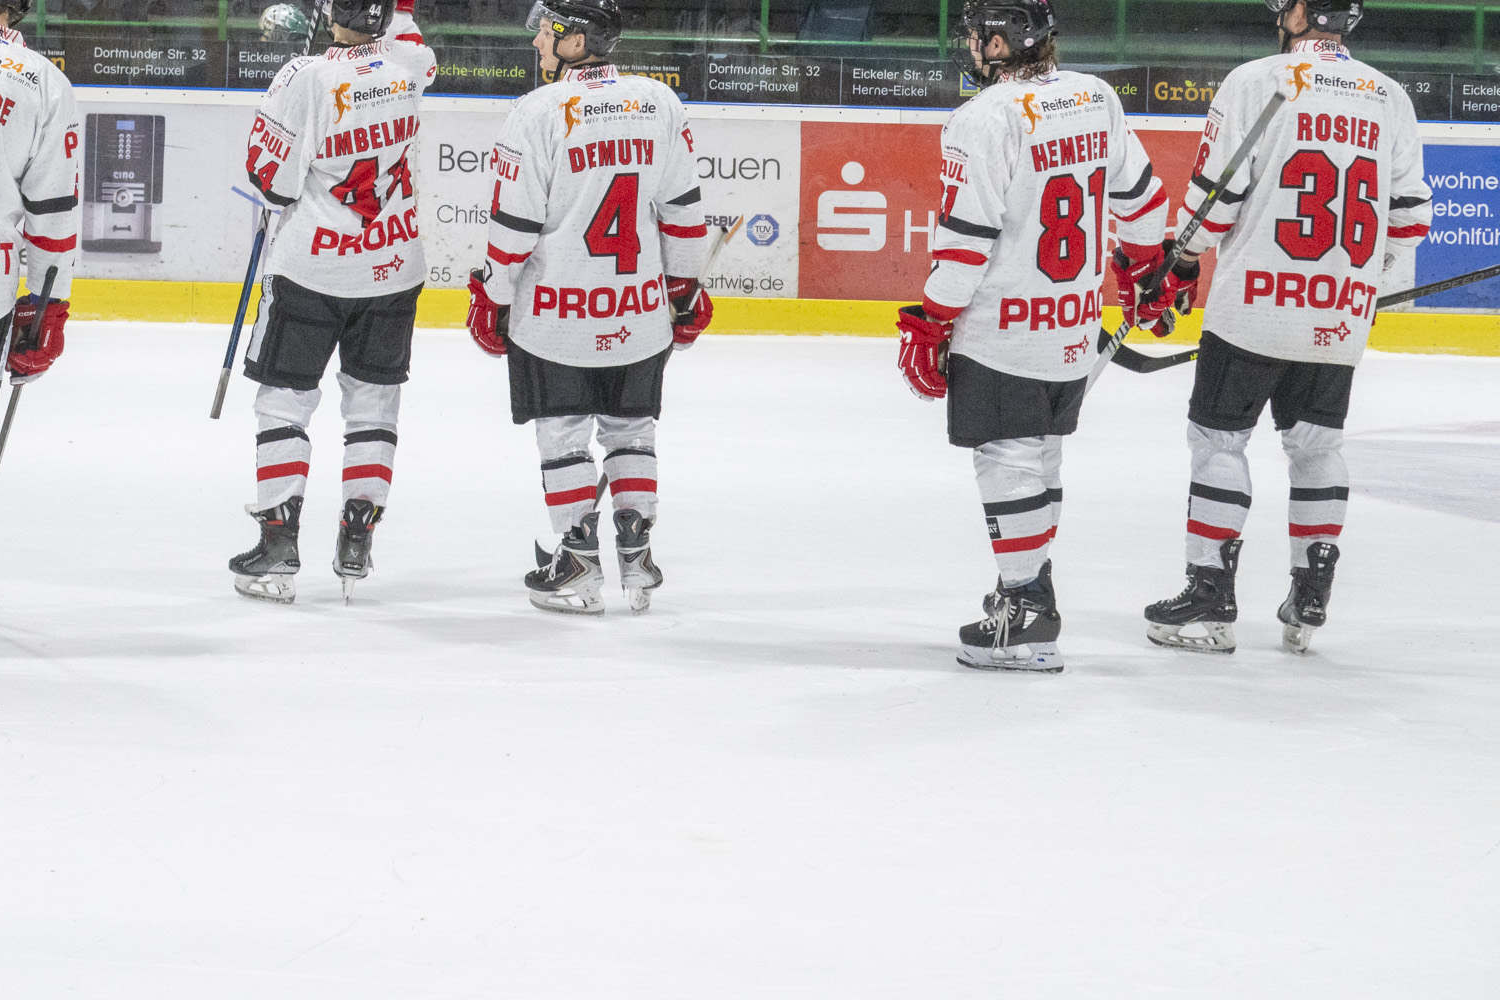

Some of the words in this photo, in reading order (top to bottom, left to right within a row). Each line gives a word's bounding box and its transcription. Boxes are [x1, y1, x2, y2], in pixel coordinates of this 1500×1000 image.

[368, 3, 382, 17] 44
[94, 47, 163, 60] Dortmunder
[168, 48, 187, 60] Str.
[192, 49, 206, 60] 32
[239, 52, 286, 63] Eickeler
[94, 64, 185, 77] Castrop-Rauxel
[239, 67, 276, 79] Herne-
[436, 65, 526, 79] ische-revier.de
[709, 63, 778, 77] Dortmunder
[781, 65, 801, 77] Str.
[806, 66, 820, 77] 32
[852, 68, 899, 81] Eickeler
[903, 70, 923, 81] Str.
[929, 70, 942, 81] 25
[353, 79, 417, 103] Reifen24.de
[709, 79, 799, 93] Castrop-Rauxel
[852, 84, 928, 97] Herne-Eickel
[1314, 86, 1329, 94] Wir
[1333, 89, 1361, 99] geben
[1416, 83, 1430, 93] 32
[1463, 85, 1500, 96] Eickele
[355, 103, 368, 111] Wir
[371, 97, 395, 108] geben
[584, 99, 656, 117] Reifen24.de
[1041, 91, 1104, 112] Reifen24.de
[1462, 101, 1500, 112] Herne-
[585, 117, 599, 125] Wir
[603, 114, 628, 123] geben
[1045, 113, 1058, 121] Wir
[1061, 108, 1082, 119] geben
[250, 116, 292, 163] PAULI
[316, 115, 421, 160] IMBELMA
[1204, 119, 1219, 143] ULI
[1297, 112, 1380, 151] ROSIER
[439, 143, 489, 173] Ber
[568, 139, 654, 174] DEMUTH
[1031, 131, 1108, 172] HEMEIER
[490, 147, 520, 182] PULI
[1428, 171, 1500, 190] wohne
[1274, 149, 1379, 268] 36
[1433, 199, 1494, 218] eben.
[311, 203, 419, 257] PROAC
[583, 172, 641, 275] 4
[1037, 166, 1107, 283] 81
[1172, 218, 1201, 259] ALPHA
[703, 274, 784, 294] artwig.de
[1400, 271, 1486, 302] JETSPEED
[1244, 270, 1377, 321] PROACT
